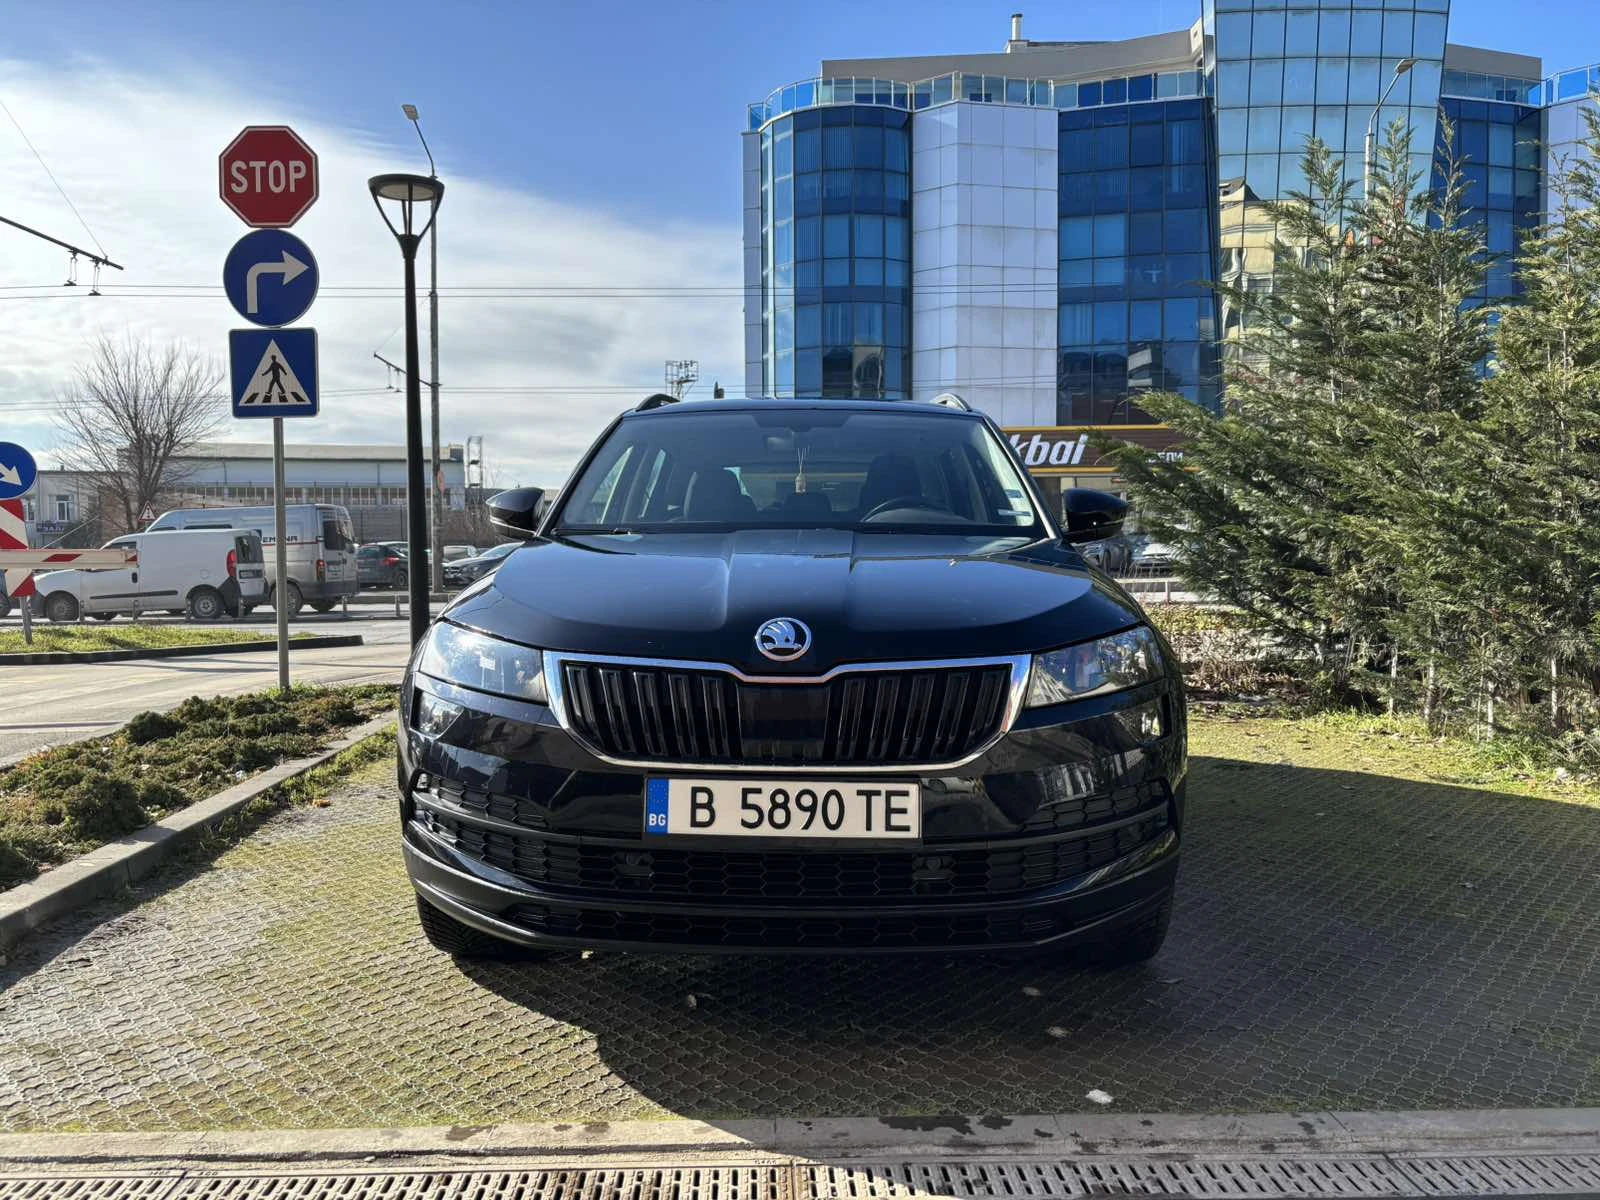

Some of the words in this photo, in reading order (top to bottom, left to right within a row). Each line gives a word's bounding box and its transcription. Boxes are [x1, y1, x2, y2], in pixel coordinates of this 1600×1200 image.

[231, 160, 307, 193] STOP
[648, 813, 667, 826] BG
[690, 786, 716, 828] B
[740, 787, 845, 831] 5890
[856, 790, 911, 832] TE
